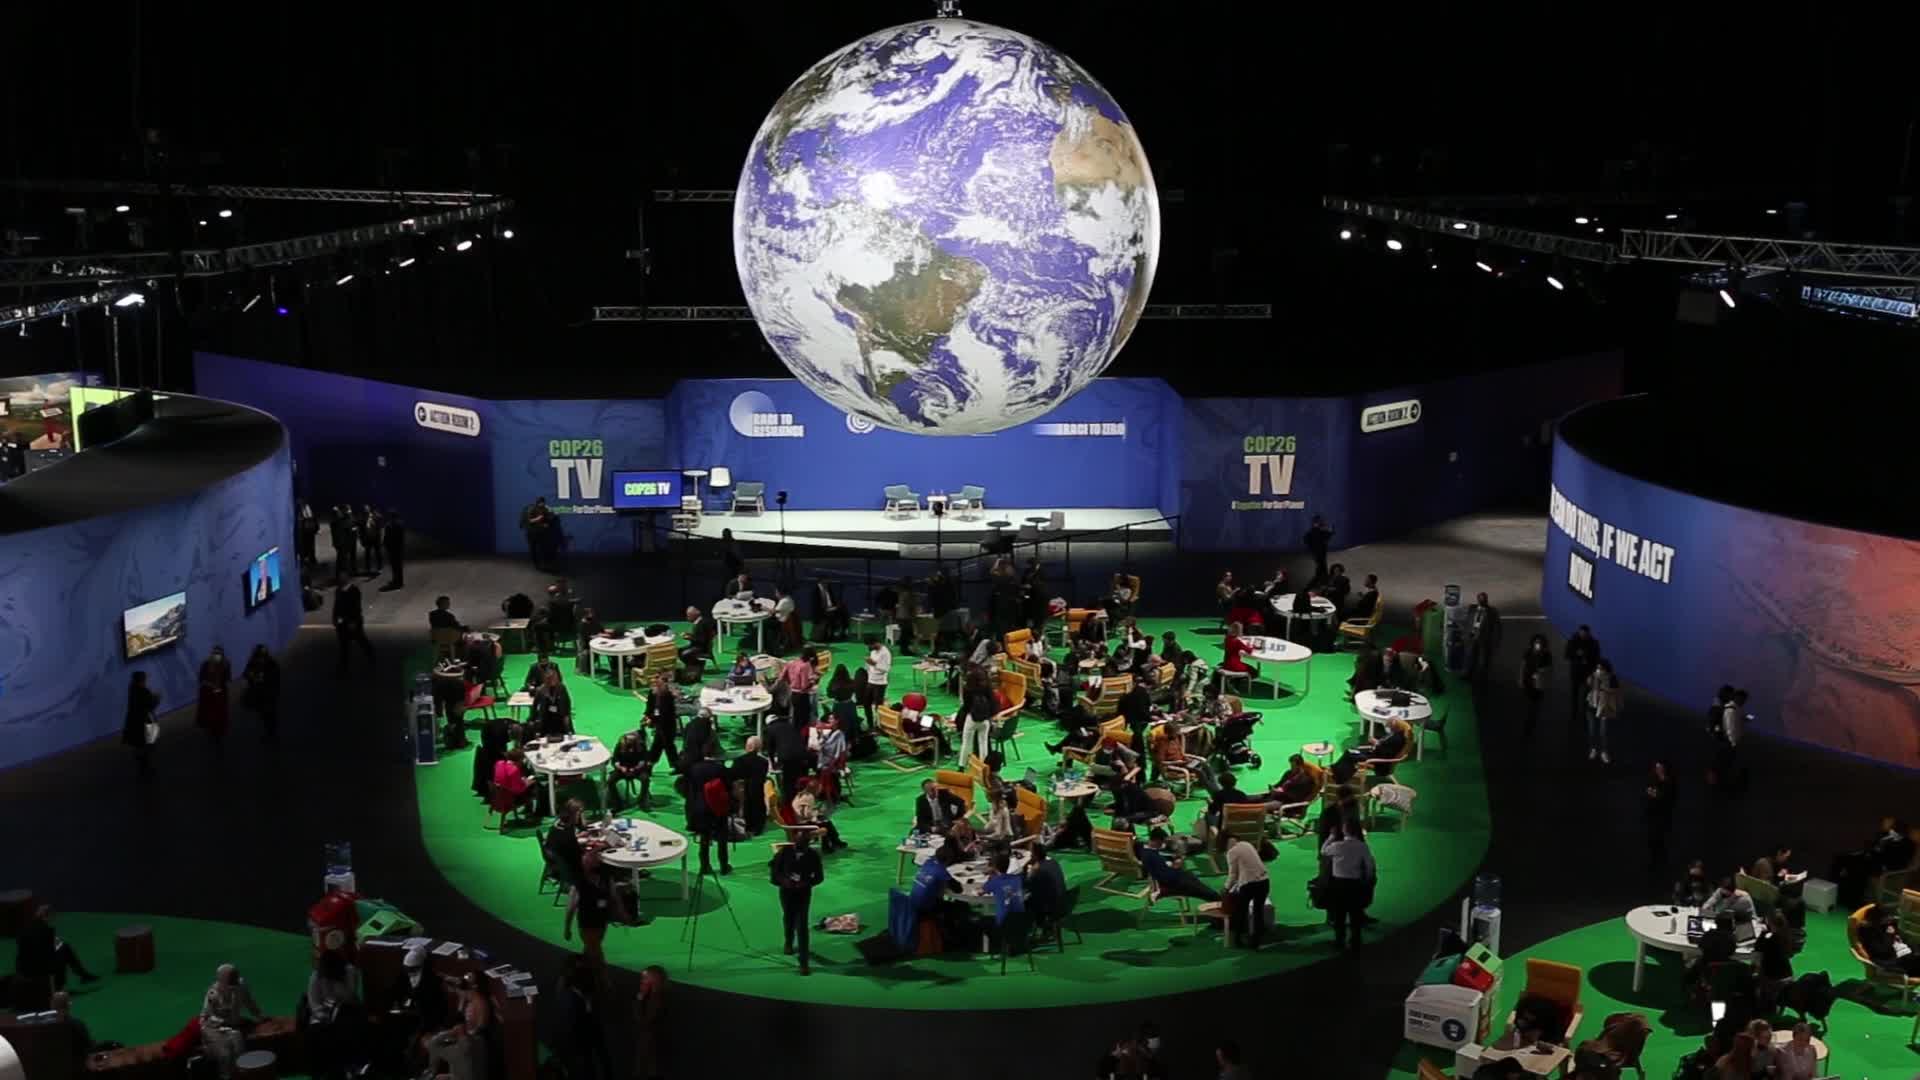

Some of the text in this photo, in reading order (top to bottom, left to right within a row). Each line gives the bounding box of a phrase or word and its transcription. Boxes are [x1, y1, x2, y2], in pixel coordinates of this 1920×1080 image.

[781, 413, 793, 425] TO
[549, 440, 603, 457] COP26
[1244, 436, 1296, 453] COP26
[551, 459, 603, 499] TV
[624, 482, 671, 496] COP26 TV
[1244, 455, 1295, 495] TV
[1577, 509, 1600, 559] THIS,
[1602, 523, 1616, 559] IF
[1616, 529, 1639, 572] WE
[1638, 540, 1675, 584] ACT
[1568, 552, 1593, 599] NOW.
